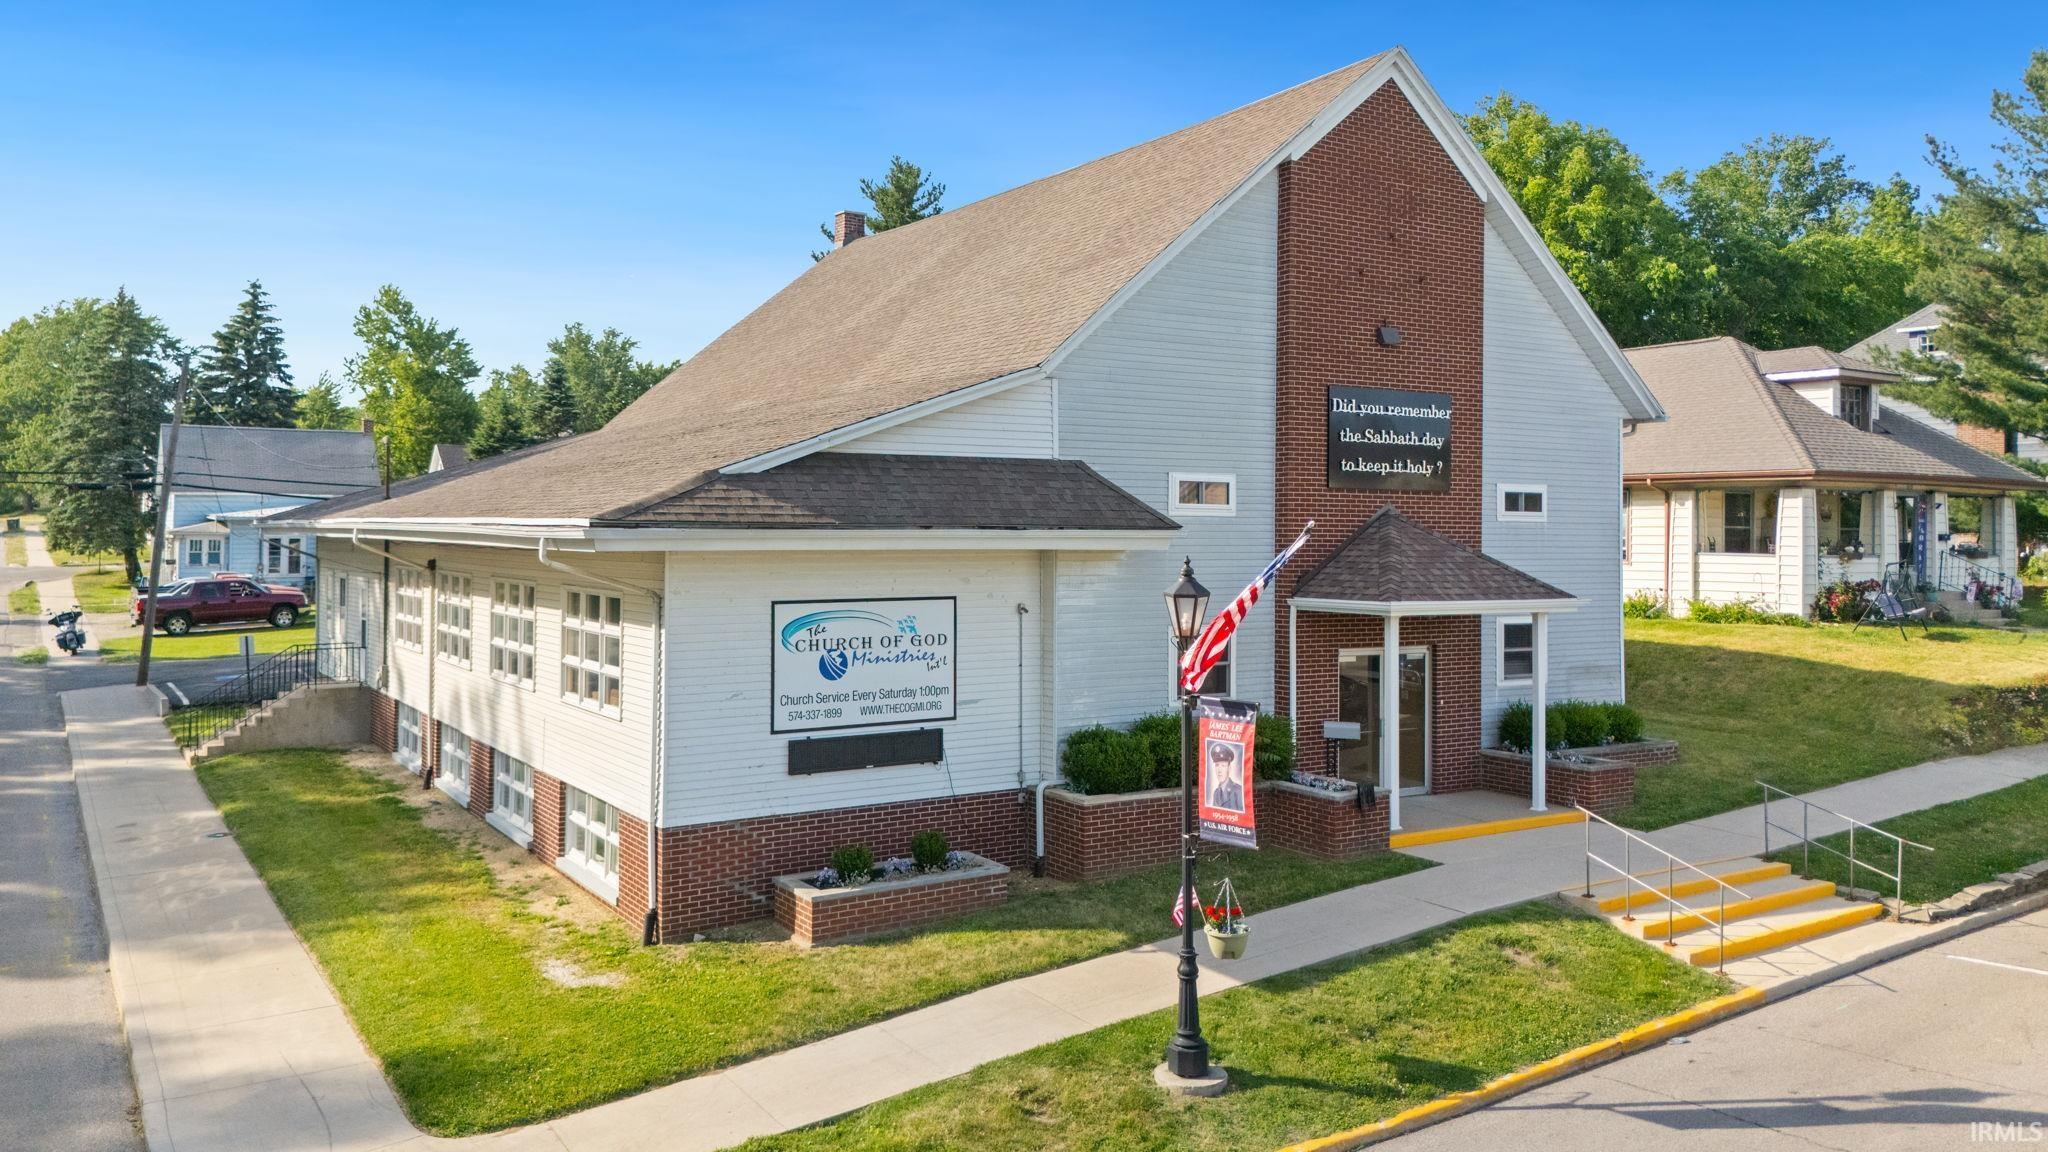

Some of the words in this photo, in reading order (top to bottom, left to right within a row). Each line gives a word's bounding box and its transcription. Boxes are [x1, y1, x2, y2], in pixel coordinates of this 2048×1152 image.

[1332, 398, 1356, 412] Did
[1360, 404, 1384, 416] you
[1387, 405, 1452, 419] remember
[1340, 428, 1361, 443] the
[1364, 428, 1418, 445] Sabbath
[1422, 432, 1444, 449] day
[1341, 458, 1355, 471] to
[1359, 458, 1390, 475] keep
[1393, 459, 1403, 472] it
[1406, 459, 1434, 477] holy
[806, 624, 828, 638] The
[795, 636, 873, 653] CHURCH
[880, 635, 904, 648] OF
[910, 633, 947, 647] GOD
[851, 649, 936, 667] Ministries
[780, 693, 814, 707] Church
[816, 692, 850, 704] Service
[852, 690, 877, 703] Every
[879, 687, 916, 701] Saturday
[919, 685, 949, 698] 1:00pm
[788, 708, 842, 721] 574-337-1899
[860, 701, 942, 716] WWW.THECOGMI.ORG
[1231, 724, 1244, 733] LEE
[1228, 825, 1246, 835] FORCE
